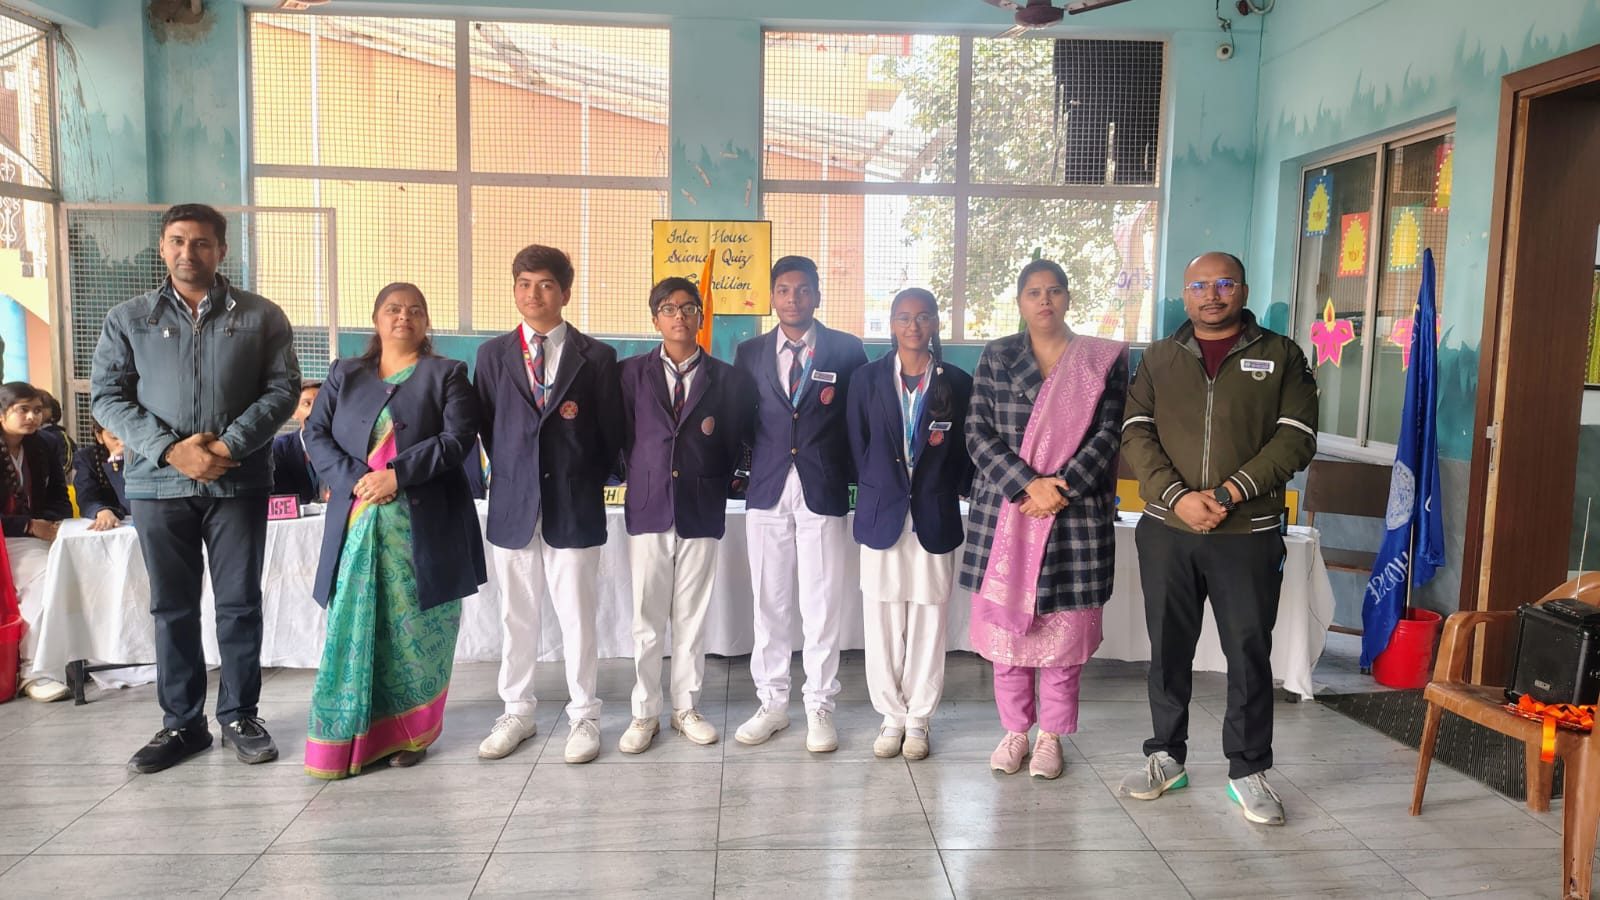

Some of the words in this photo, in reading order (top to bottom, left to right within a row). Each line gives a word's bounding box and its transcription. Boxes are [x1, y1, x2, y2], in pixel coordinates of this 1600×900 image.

[667, 228, 698, 243] Inter
[712, 228, 752, 243] House
[664, 249, 709, 264] Scienc
[722, 248, 753, 269] Quiz
